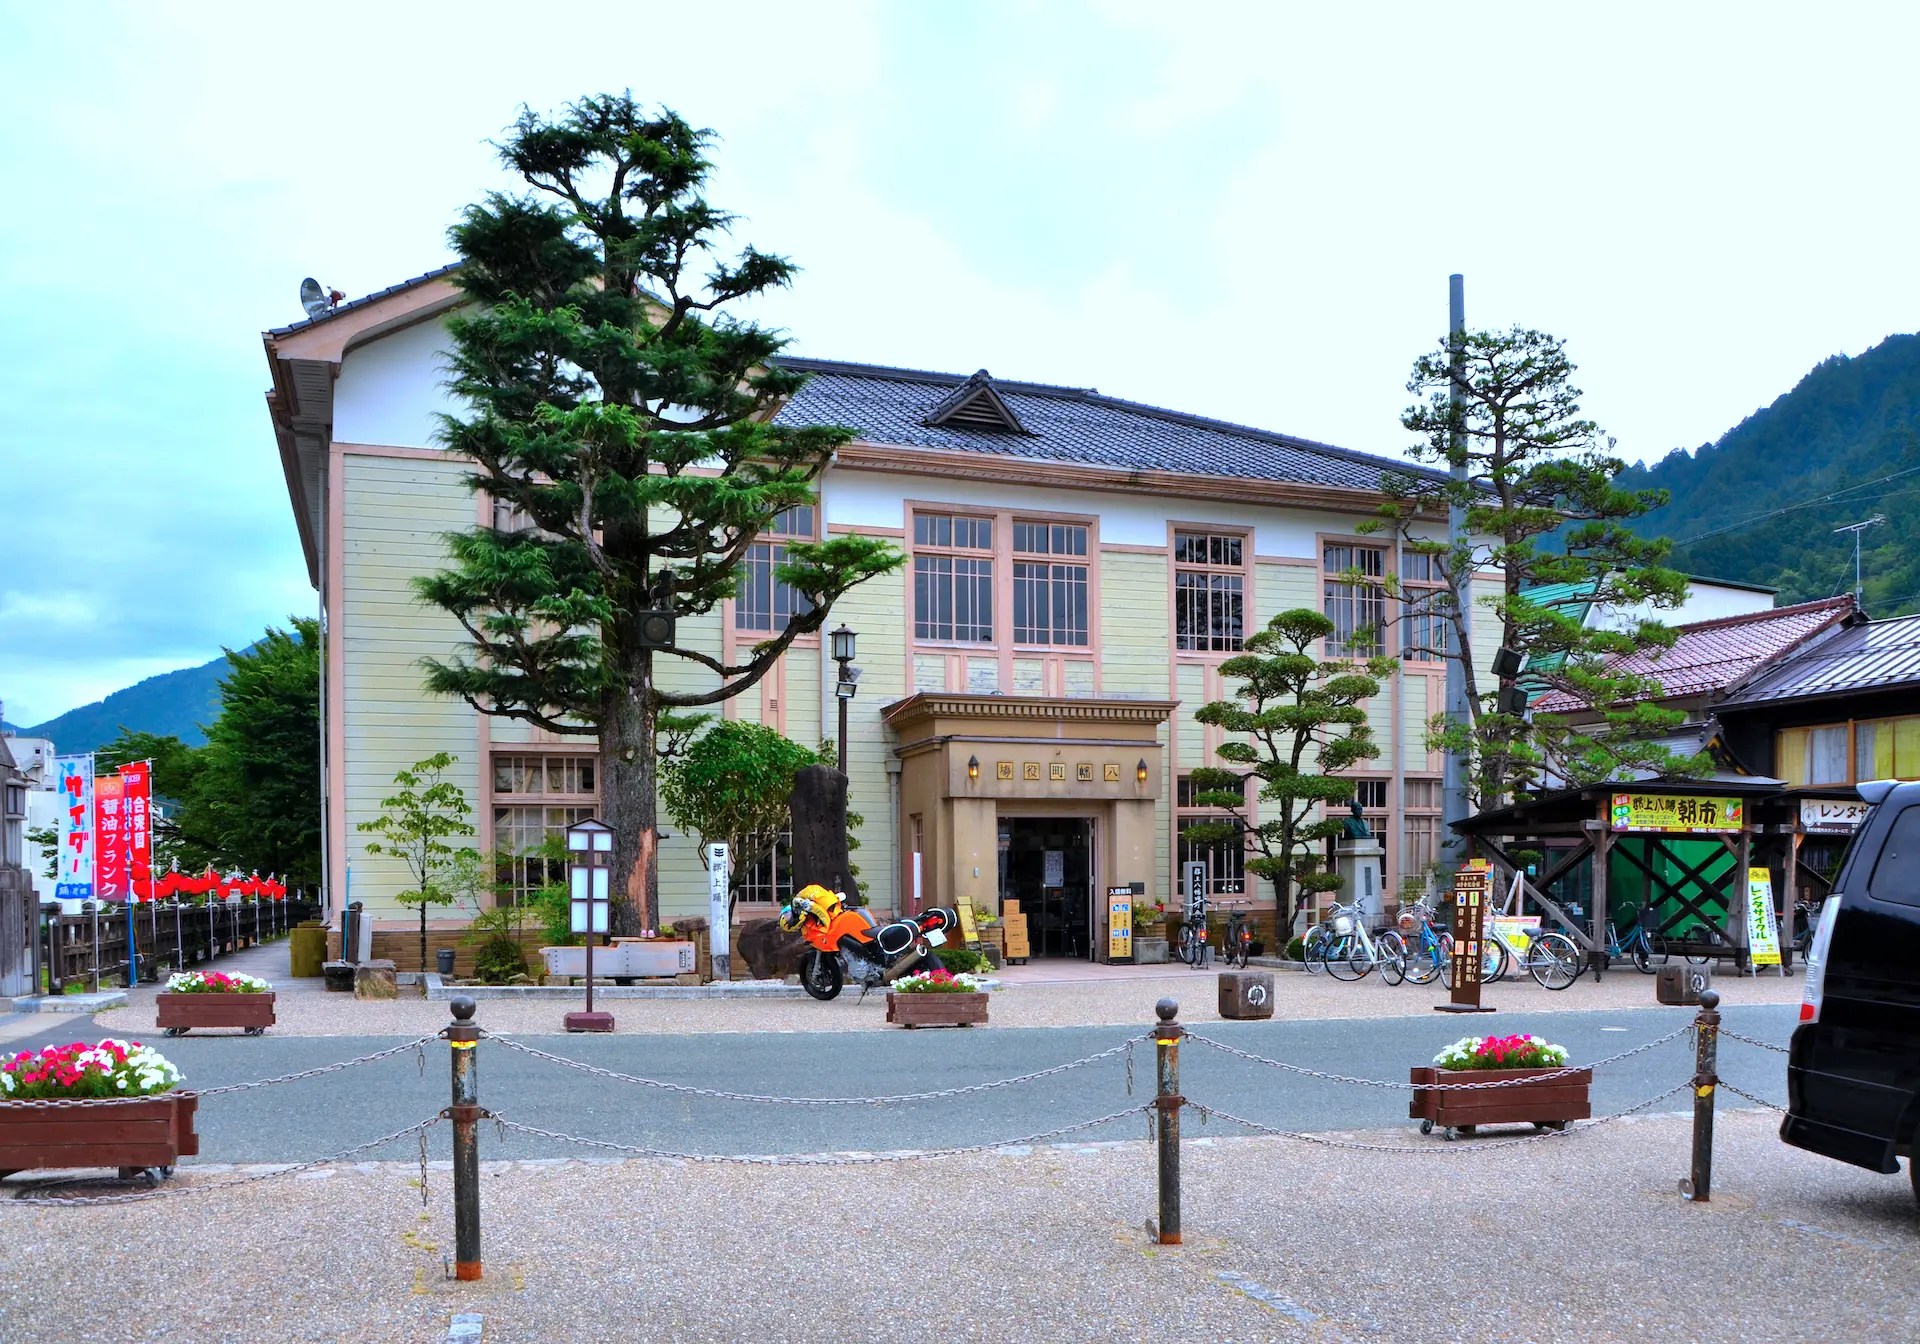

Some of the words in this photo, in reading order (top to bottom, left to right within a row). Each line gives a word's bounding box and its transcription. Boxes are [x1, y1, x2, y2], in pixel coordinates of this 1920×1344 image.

[65, 775, 89, 873] サイダー
[101, 798, 120, 897] 醤油フランク
[1677, 799, 1718, 825] 朝市
[1750, 885, 1768, 940] レンタサイクル
